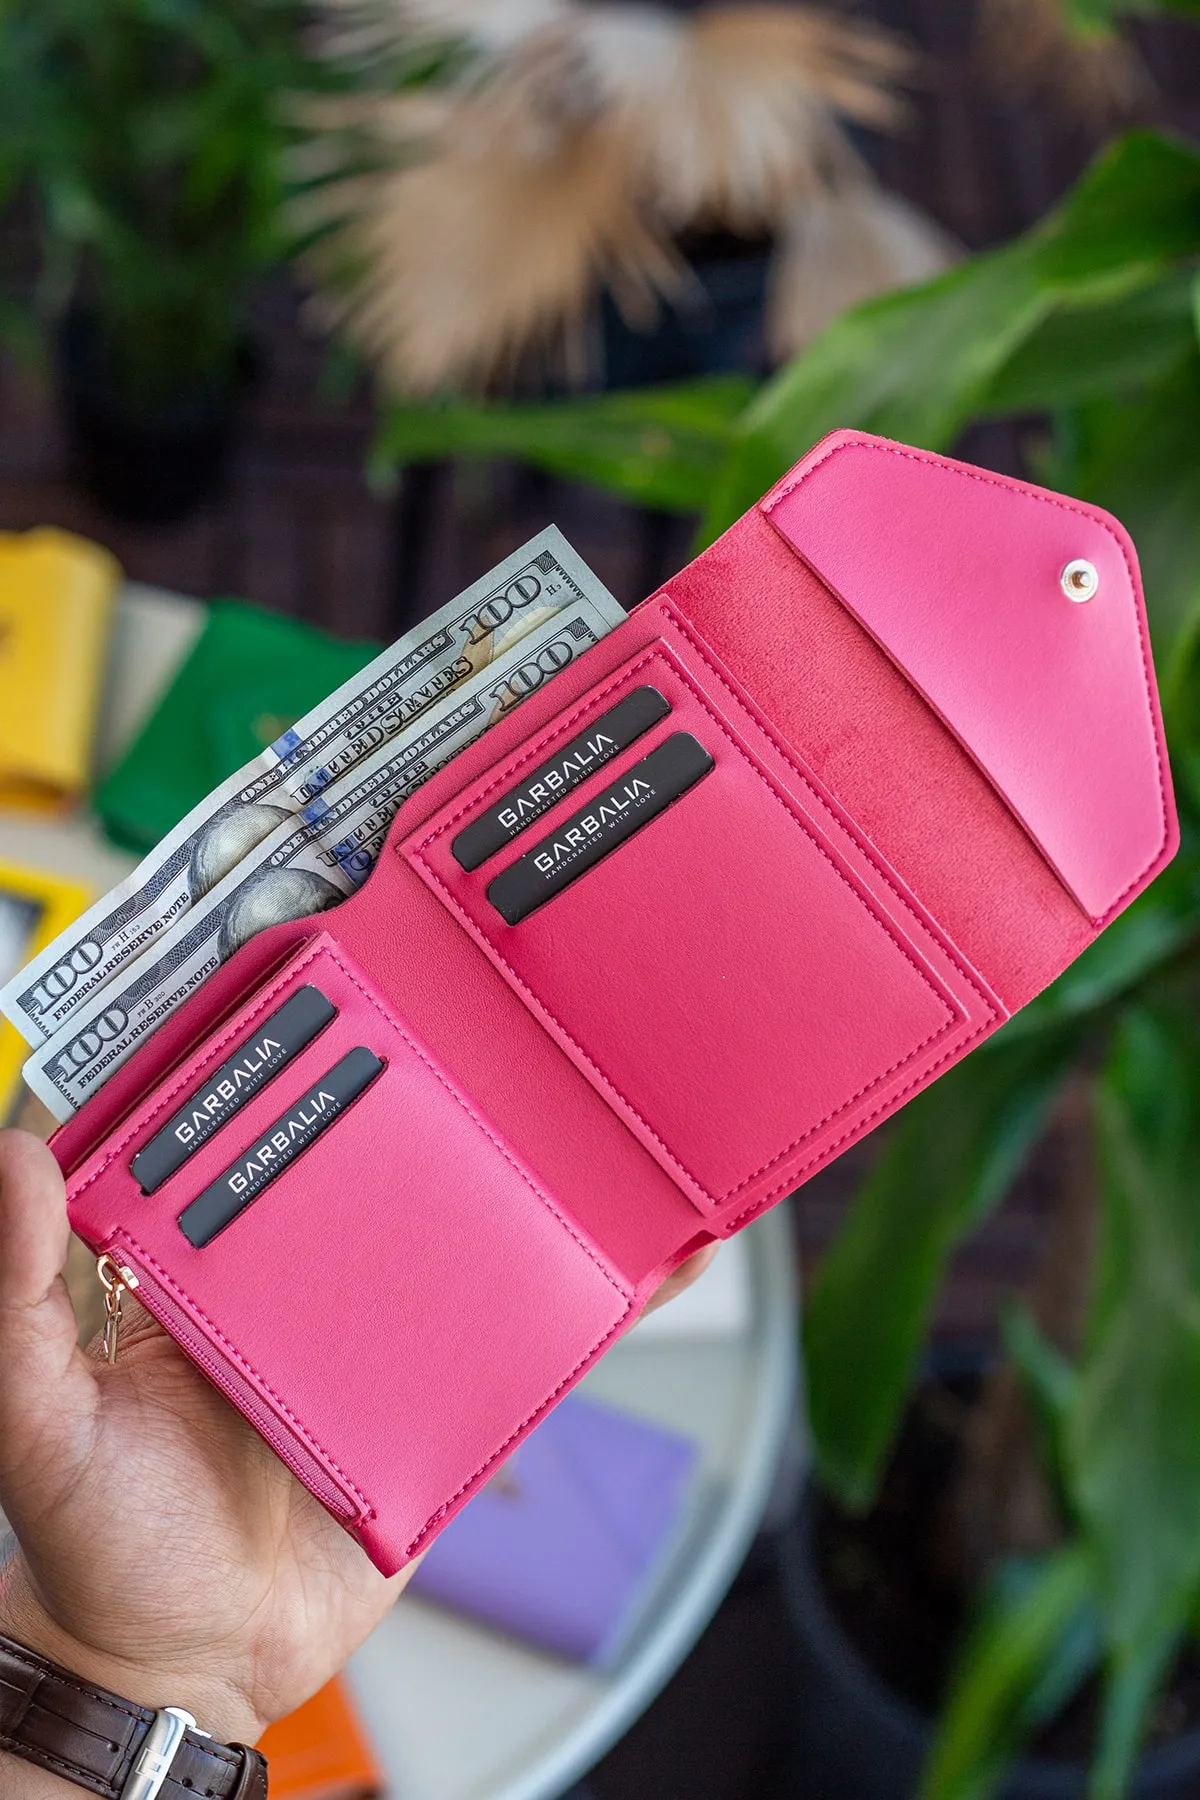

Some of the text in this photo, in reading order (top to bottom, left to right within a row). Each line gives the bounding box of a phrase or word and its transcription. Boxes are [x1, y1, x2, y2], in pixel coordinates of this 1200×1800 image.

[459, 575, 541, 645] 100
[241, 771, 279, 802] ONE
[279, 699, 366, 774] HUNDRED
[365, 634, 447, 702] DOLLARS
[489, 641, 573, 712] 100
[291, 726, 384, 806] UNITED
[380, 656, 474, 735] STATES
[270, 830, 306, 867] ONE
[304, 768, 390, 839] HUNDRED
[390, 701, 477, 772] DOLLARS
[498, 733, 614, 828] GARBALIA
[509, 744, 620, 836] HANDCRAFTED WITH LOVE
[534, 779, 650, 872] GARBALIA
[545, 789, 657, 880] HANDCRAFTED WITH LOVE
[31, 939, 104, 1016] 100
[53, 892, 190, 1021] FEDERAL RESERVE NOTE
[118, 932, 130, 944] H
[57, 1006, 129, 1084] 100
[77, 956, 218, 1089] FEDERAL RESERVE NOTE
[145, 998, 154, 1011] B
[175, 1038, 281, 1144] GARBALIA
[188, 1048, 288, 1151] HANDCRAFTED WITH LOVE
[228, 1091, 336, 1194] GARBALIA
[240, 1101, 342, 1201] HANDCRAFTED WITH LOVE
